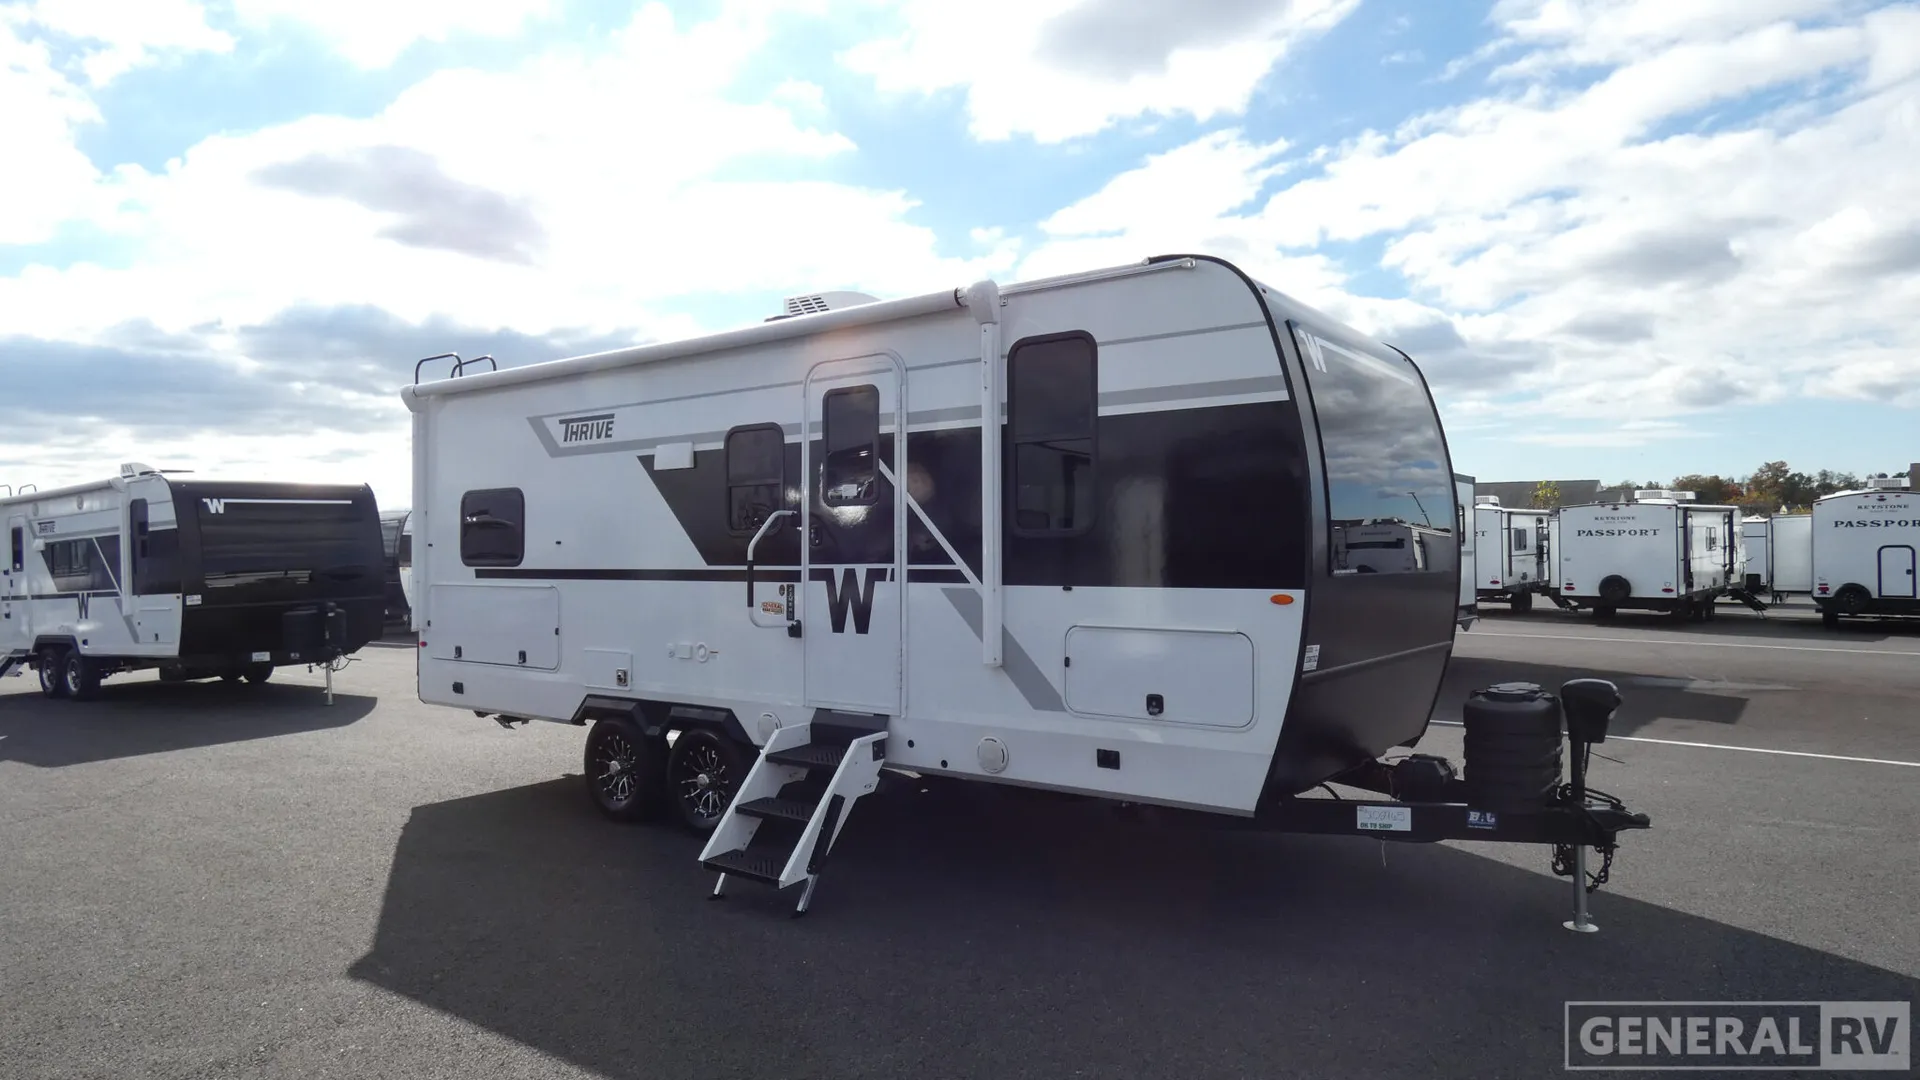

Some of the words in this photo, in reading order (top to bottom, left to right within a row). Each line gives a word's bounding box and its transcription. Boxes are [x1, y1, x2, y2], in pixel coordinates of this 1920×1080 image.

[558, 413, 616, 443] THRIVE
[1577, 529, 1660, 537] PASSPORT
[822, 567, 882, 635] W
